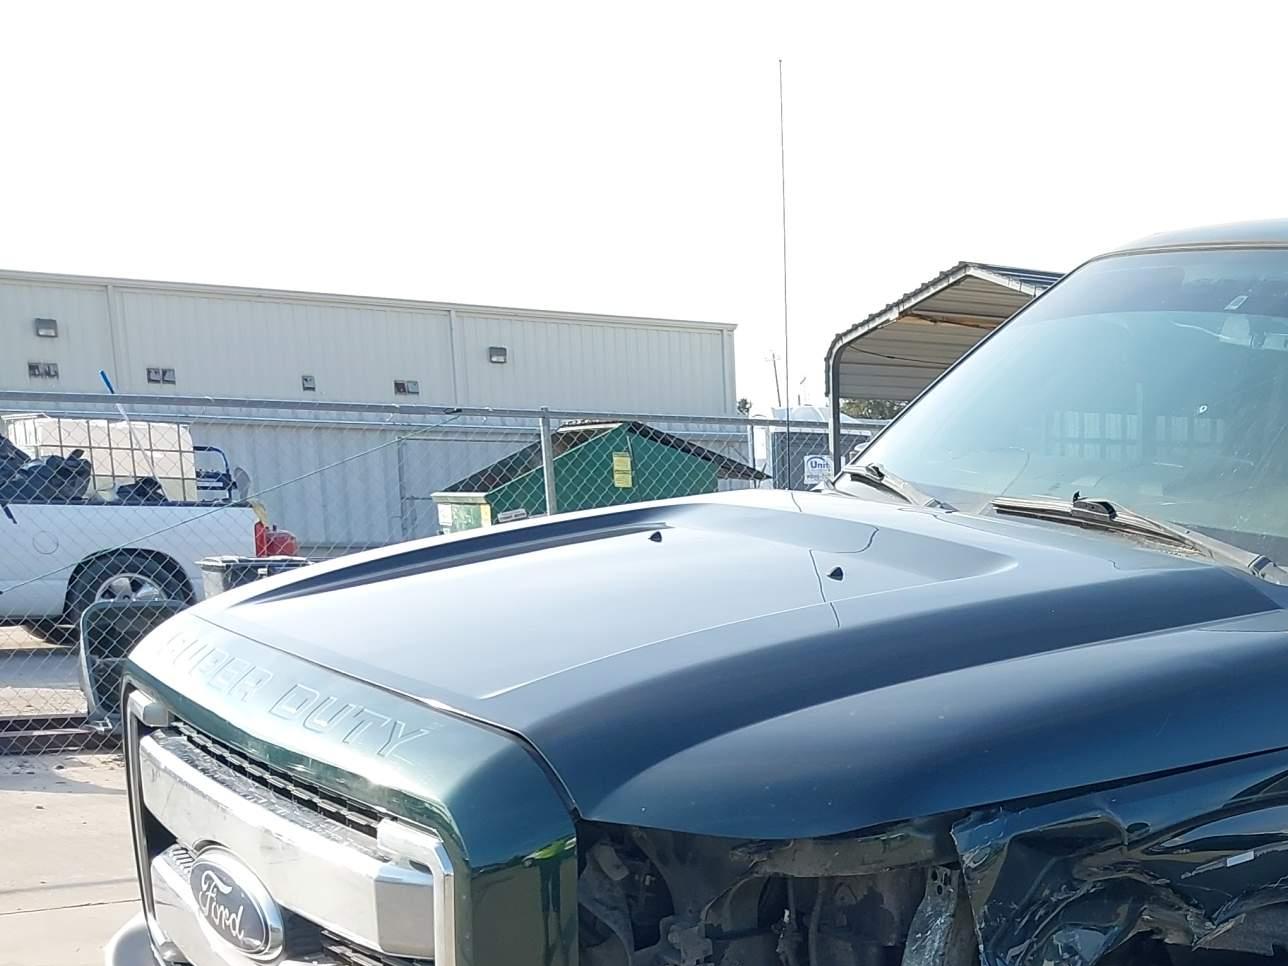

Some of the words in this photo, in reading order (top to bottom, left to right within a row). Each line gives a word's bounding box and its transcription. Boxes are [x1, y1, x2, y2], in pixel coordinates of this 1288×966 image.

[162, 631, 273, 702] SUPER
[268, 683, 431, 758] DUTY
[199, 869, 244, 940] Ford
